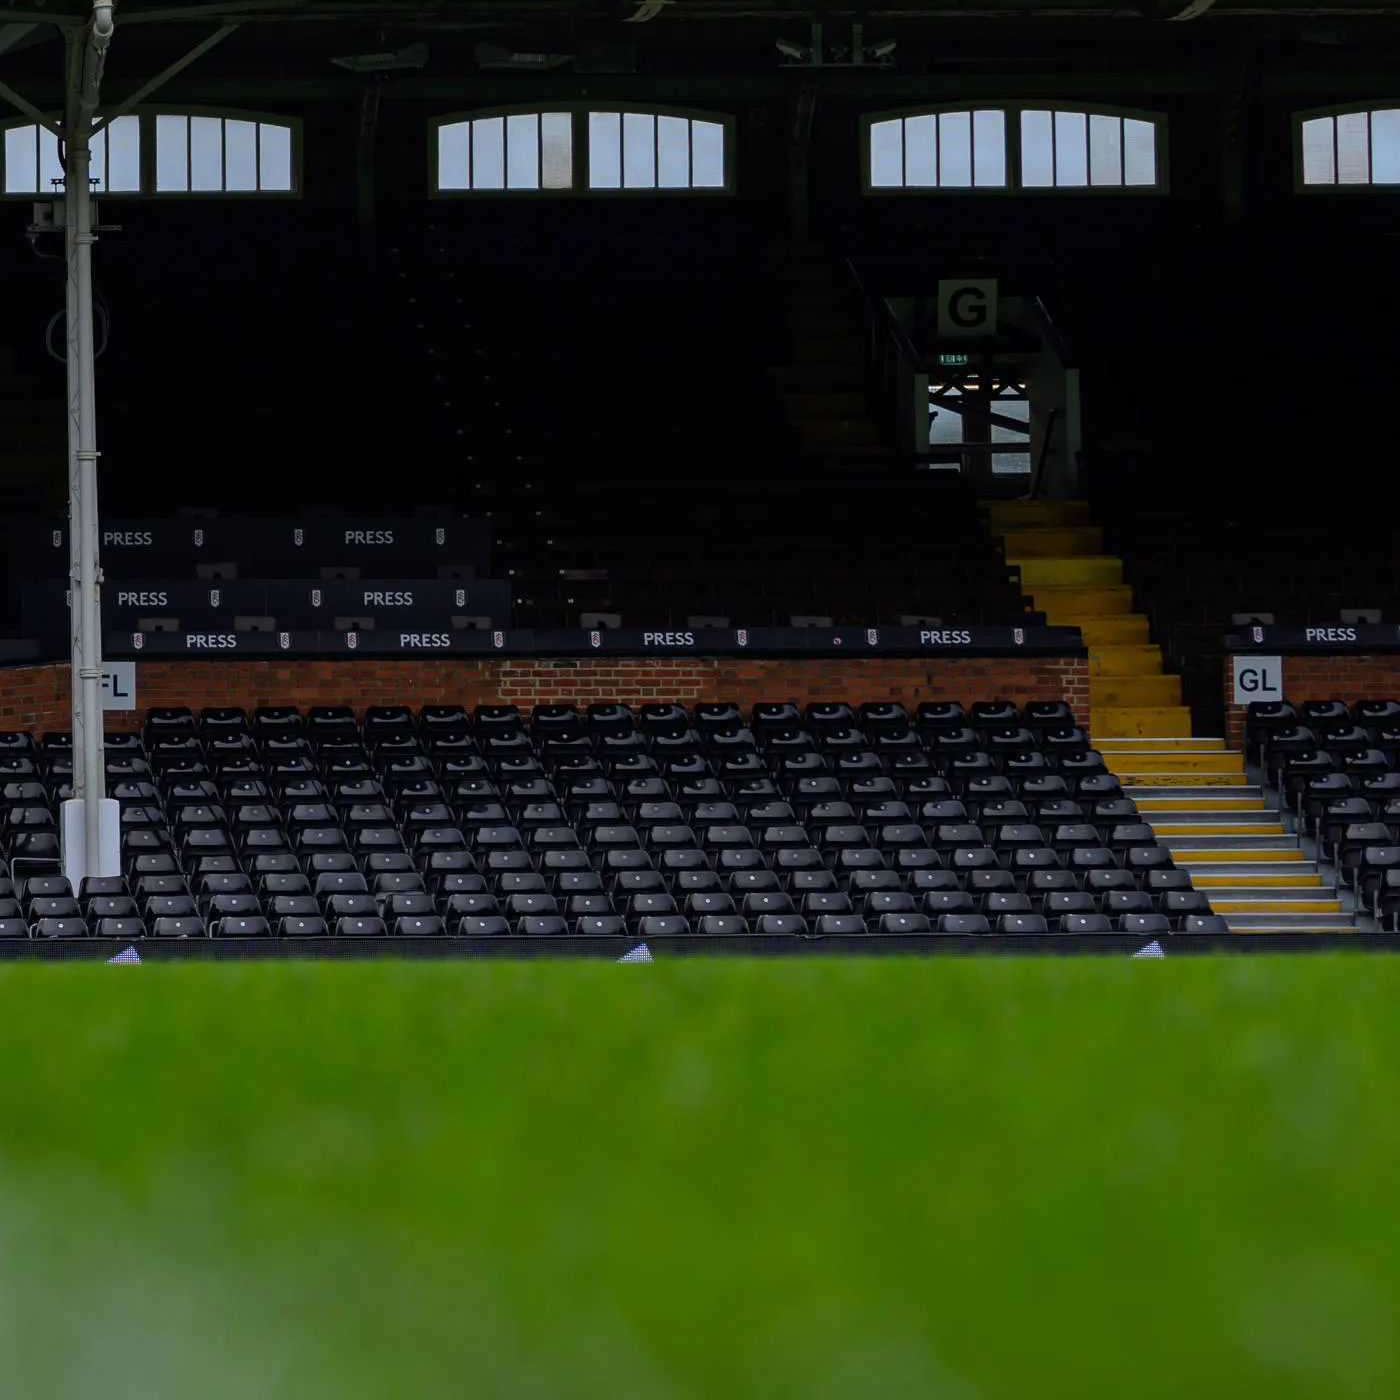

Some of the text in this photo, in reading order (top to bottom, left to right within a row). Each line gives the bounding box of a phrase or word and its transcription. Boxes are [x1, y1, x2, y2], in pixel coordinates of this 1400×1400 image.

[948, 286, 987, 328] G
[103, 531, 153, 546] PRESS
[345, 530, 394, 545] PRESS
[118, 591, 168, 606] PRESS
[363, 591, 413, 606] PRESS
[186, 634, 237, 648] PRESS
[399, 633, 451, 648] PRESS
[643, 632, 695, 646] PRESS
[920, 630, 971, 644] PRESS
[1305, 627, 1357, 642] PRESS
[1240, 668, 1277, 692] GL
